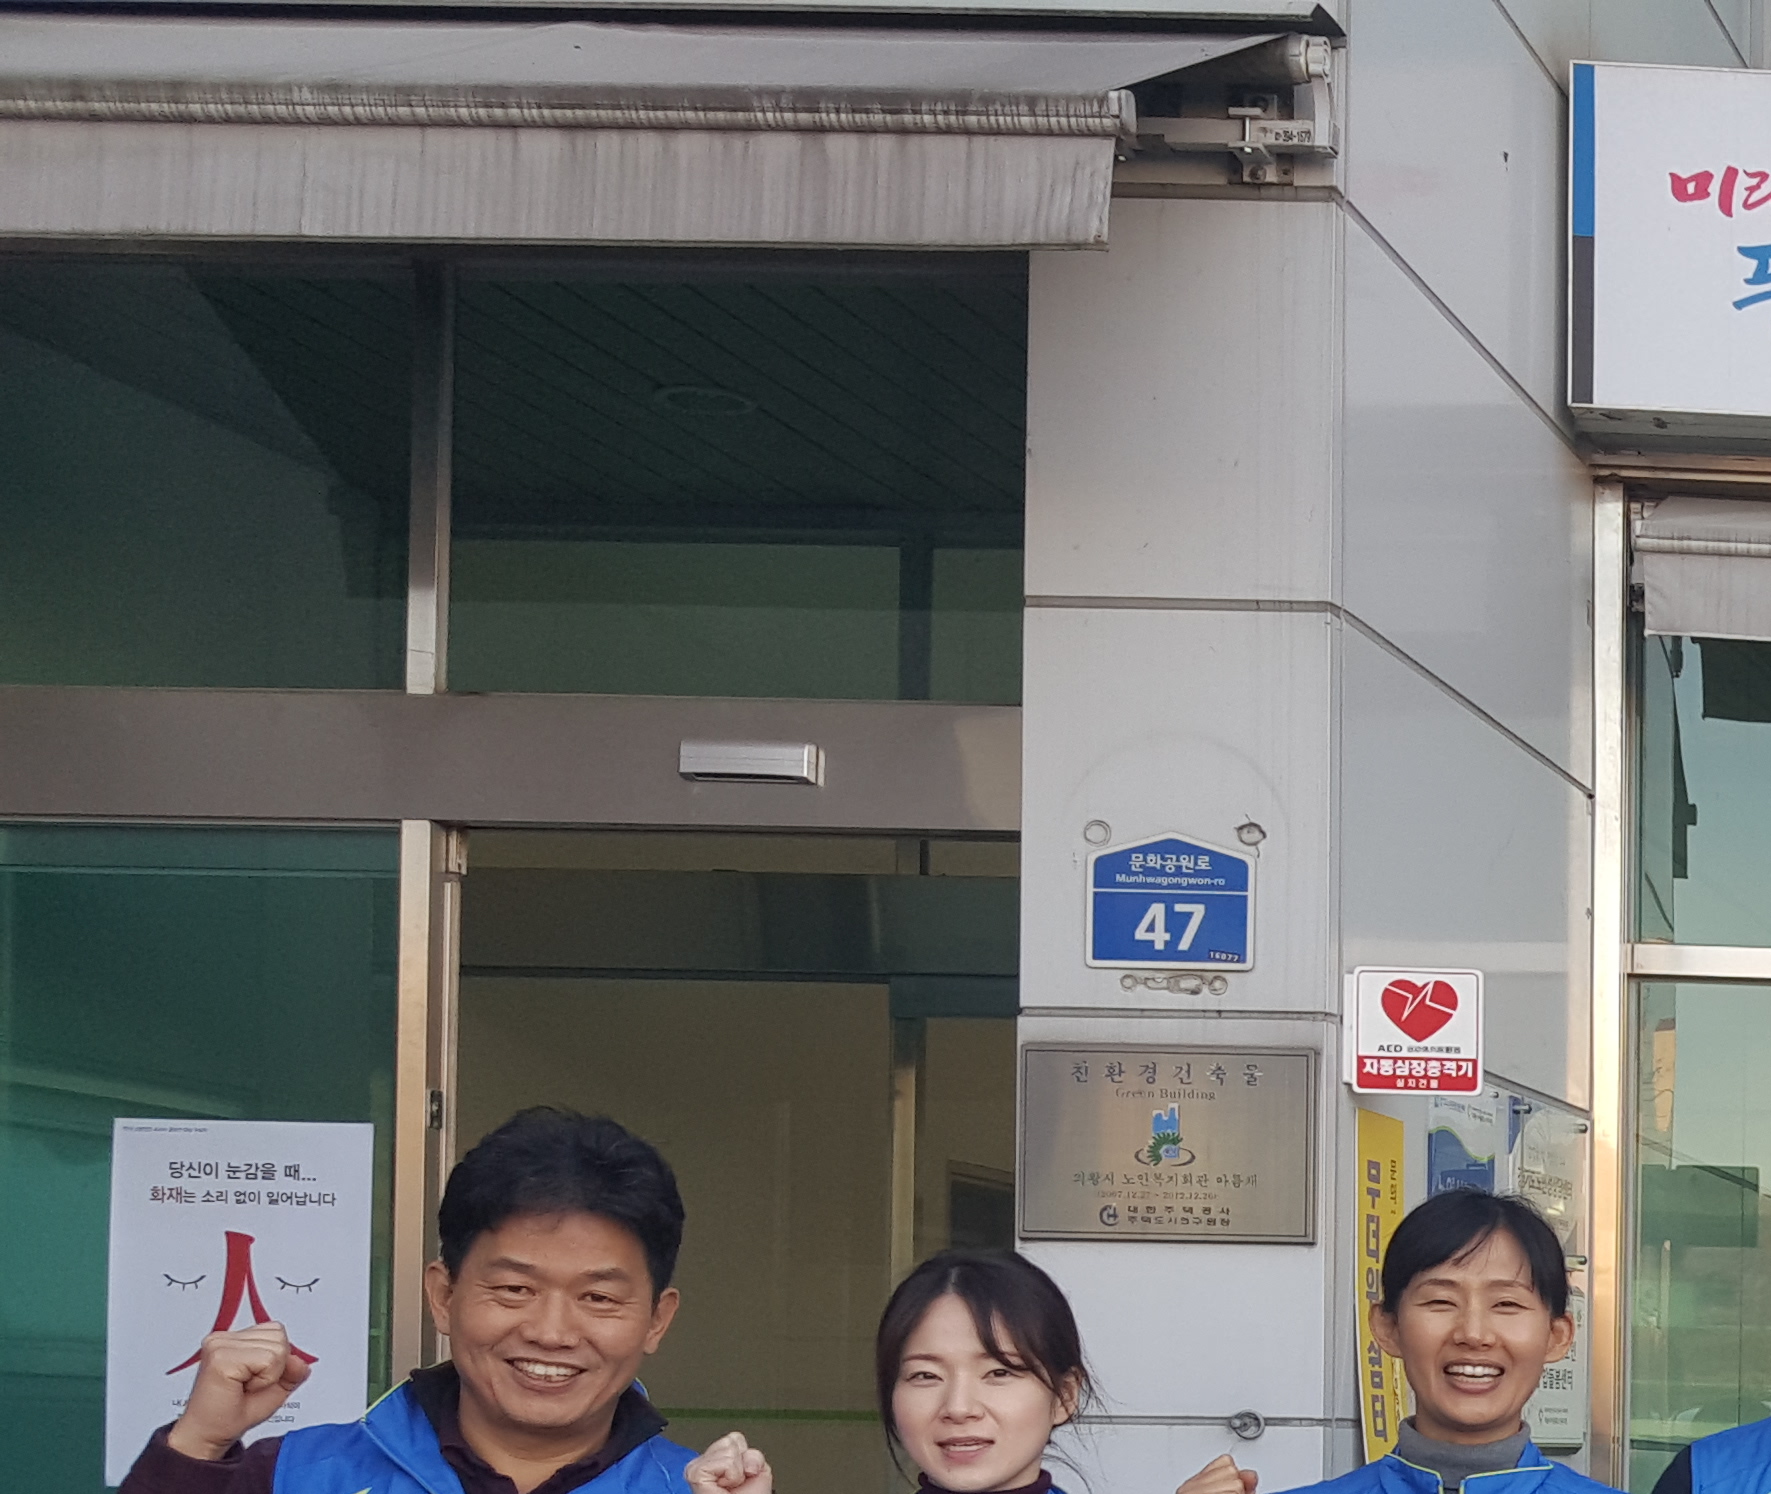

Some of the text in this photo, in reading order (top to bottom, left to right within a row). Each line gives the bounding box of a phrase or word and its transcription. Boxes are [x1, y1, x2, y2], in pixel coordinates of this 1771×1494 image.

[1129, 853, 1212, 873] 문화공원로
[1115, 873, 1226, 886] Munhwagongwon-ro
[1134, 902, 1206, 951] 47
[1209, 951, 1240, 963] 16077
[1362, 1058, 1473, 1078] 자동심장충격기
[1115, 1087, 1216, 1101] Green Building
[168, 1161, 317, 1182] 당신이 눈감을 때...
[1073, 1171, 1114, 1186] 의왕시
[1216, 1173, 1258, 1189] 아름채
[150, 1185, 336, 1207] 화재는 소리 없이 일어납니다
